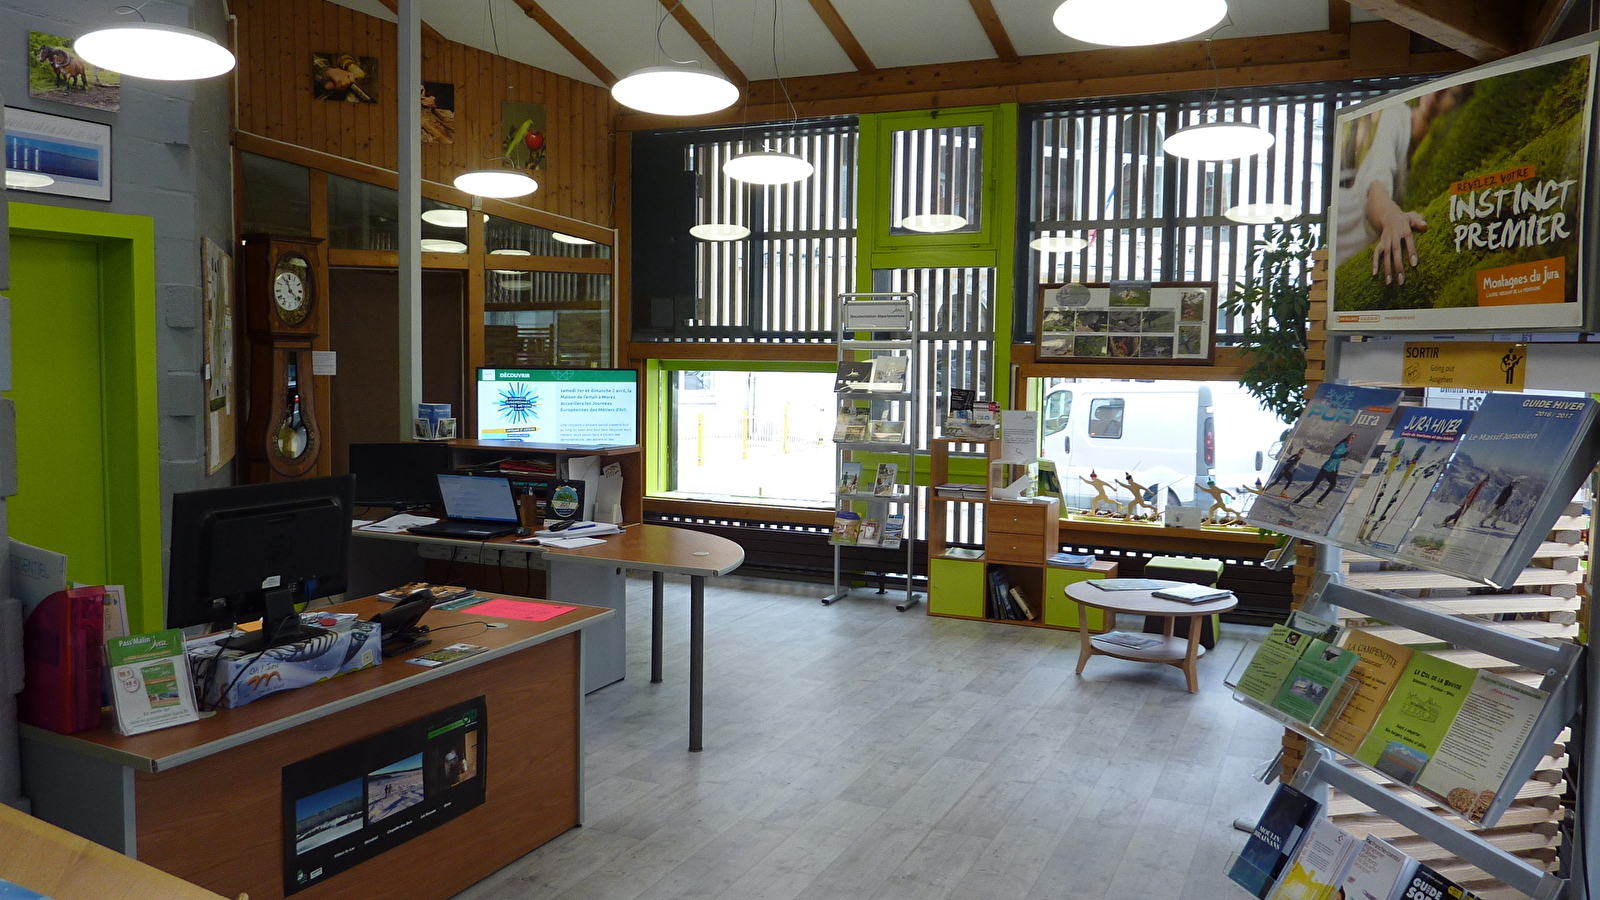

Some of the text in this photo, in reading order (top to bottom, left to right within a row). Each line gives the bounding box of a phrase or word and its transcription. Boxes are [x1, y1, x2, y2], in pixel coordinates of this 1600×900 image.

[1500, 168, 1530, 185] VOTRE
[1450, 179, 1578, 222] INSTINCT
[1454, 212, 1570, 252] PREMIER
[1483, 274, 1528, 290] Montagnes
[1530, 270, 1541, 284] du
[1406, 347, 1440, 358] SORTIR
[1430, 364, 1444, 373] Going
[1429, 376, 1454, 384] Ausgehen
[1522, 400, 1586, 410] GUIDE HIVER
[1350, 410, 1380, 427] Jura
[1404, 415, 1462, 434] JURA HIVER
[1480, 432, 1503, 440] Massif
[1502, 432, 1538, 440] Jurassien
[118, 636, 150, 648] Pass'Malin
[1347, 643, 1398, 668] LA CAMPENOTTE
[1412, 877, 1443, 900] GUIDE
